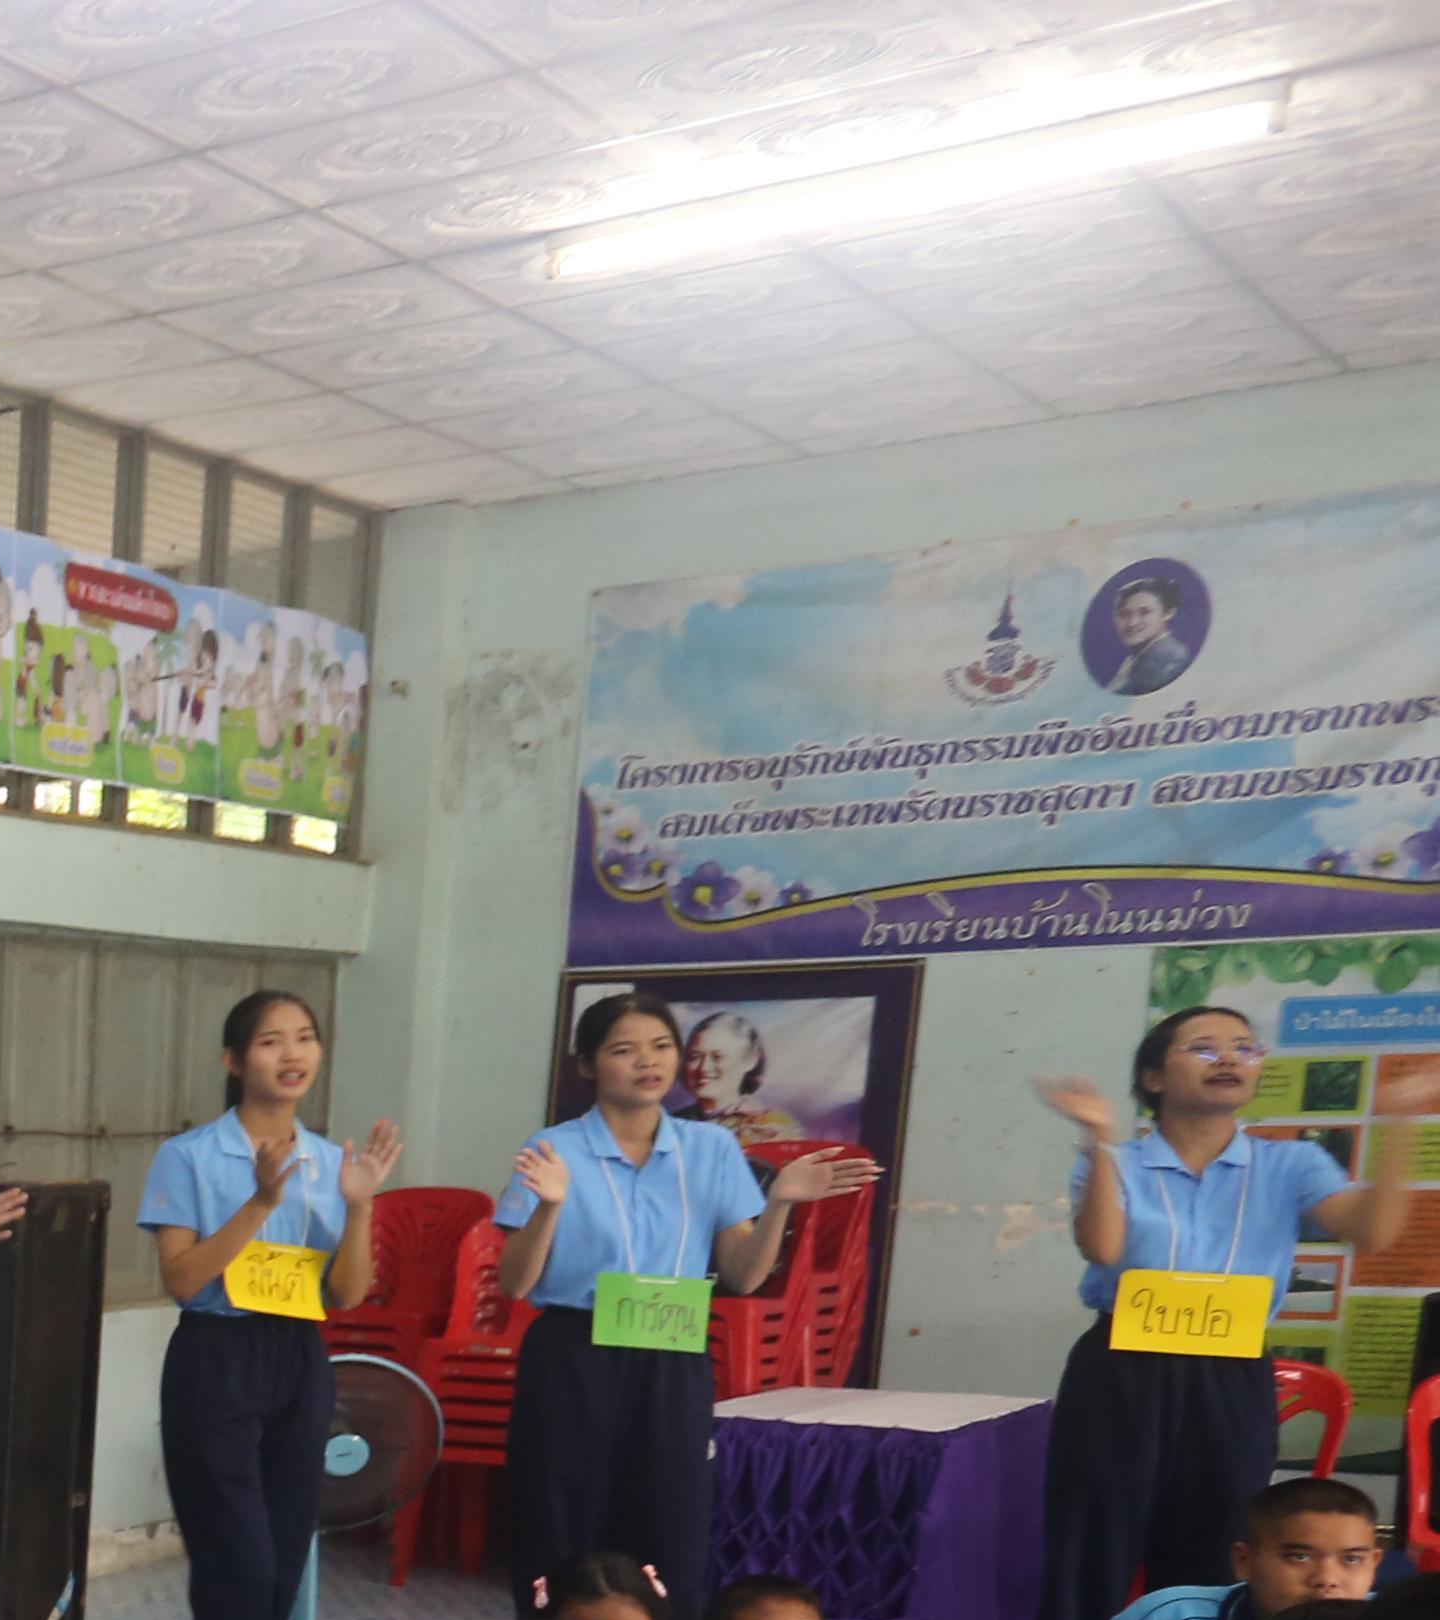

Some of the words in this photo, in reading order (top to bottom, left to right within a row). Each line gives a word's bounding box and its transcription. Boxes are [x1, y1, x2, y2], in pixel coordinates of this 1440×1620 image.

[616, 697, 1440, 791] โครงการอนุรักษ์พันธุกรรมพืชอันเนื่องมาจากพร
[854, 882, 1252, 948] โรงเรียนบ้านโนนม่วง
[1130, 1287, 1232, 1338] ใบปอ
